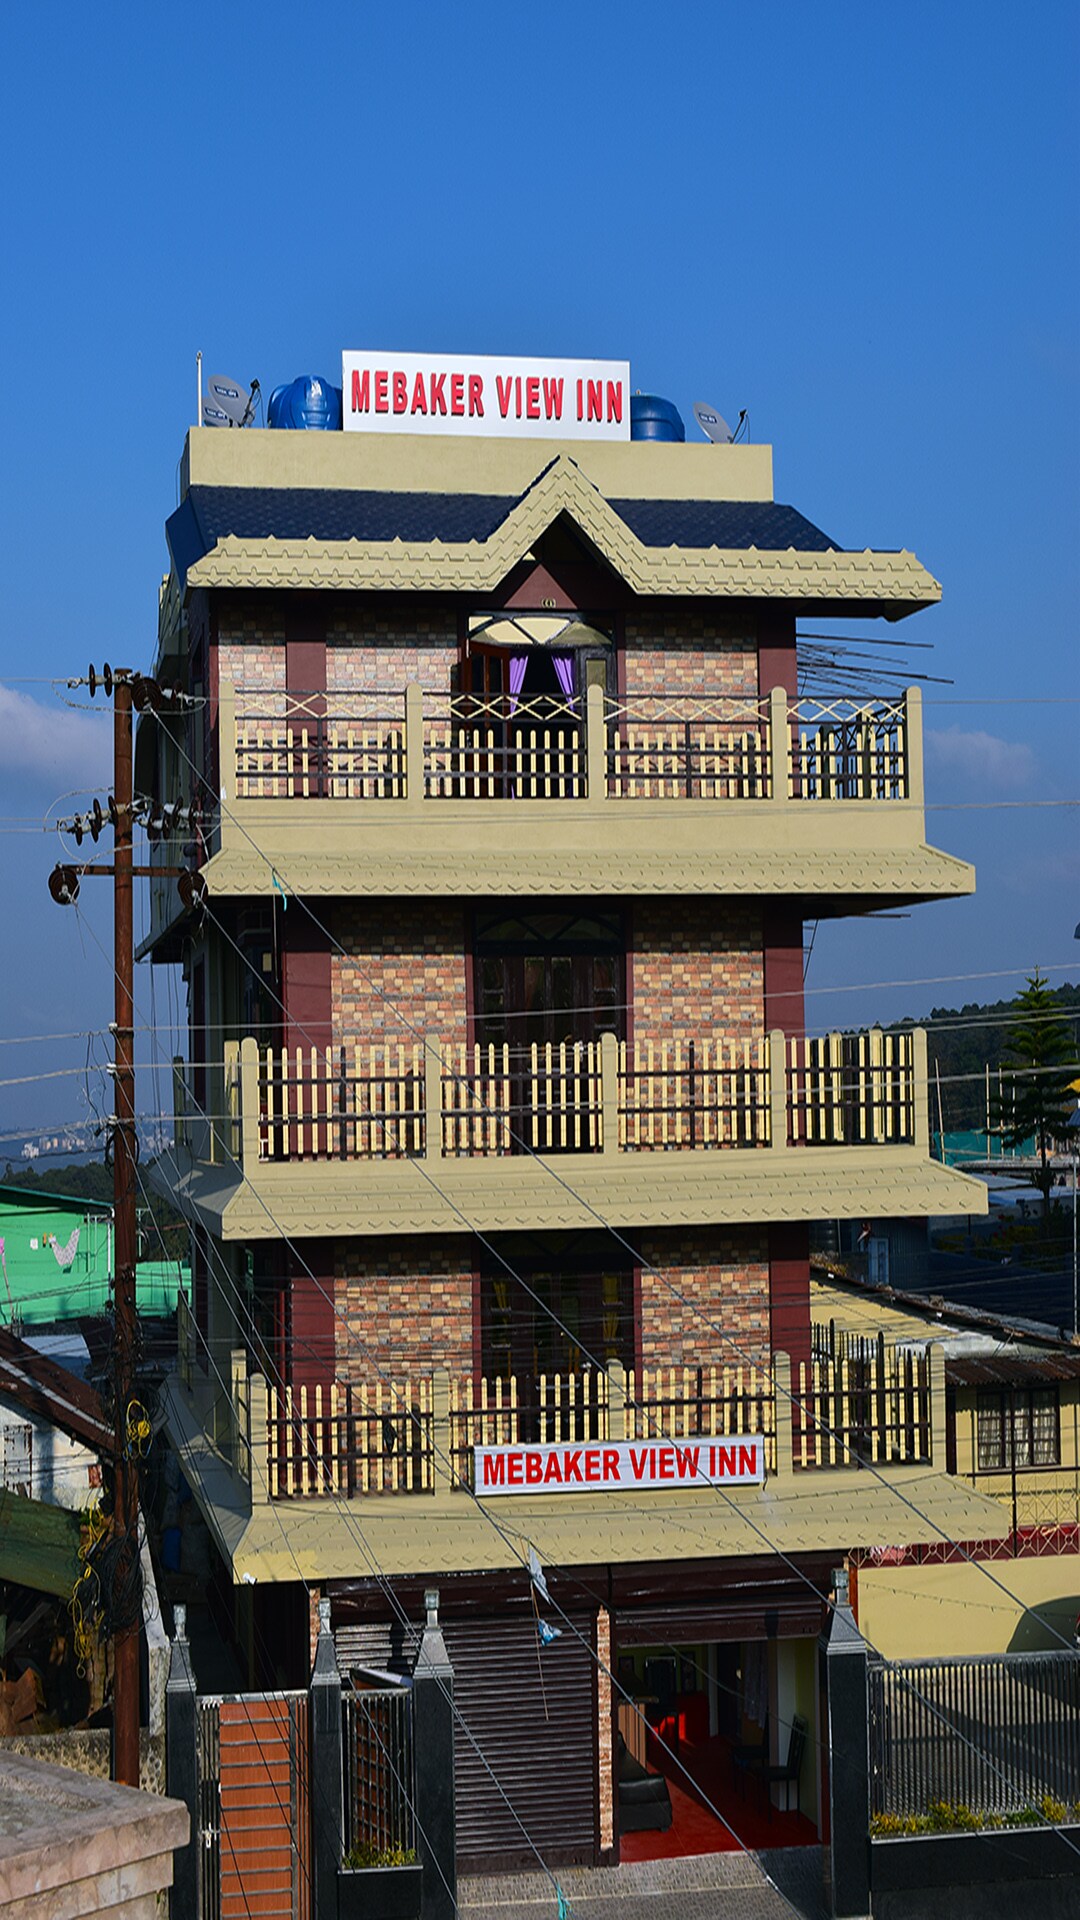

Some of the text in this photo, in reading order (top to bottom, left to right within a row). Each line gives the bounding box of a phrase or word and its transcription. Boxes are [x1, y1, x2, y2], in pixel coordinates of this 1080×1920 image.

[351, 369, 623, 424] MEBAKER VIEW INN
[483, 1444, 757, 1486] MEBAKER VIEW INN
